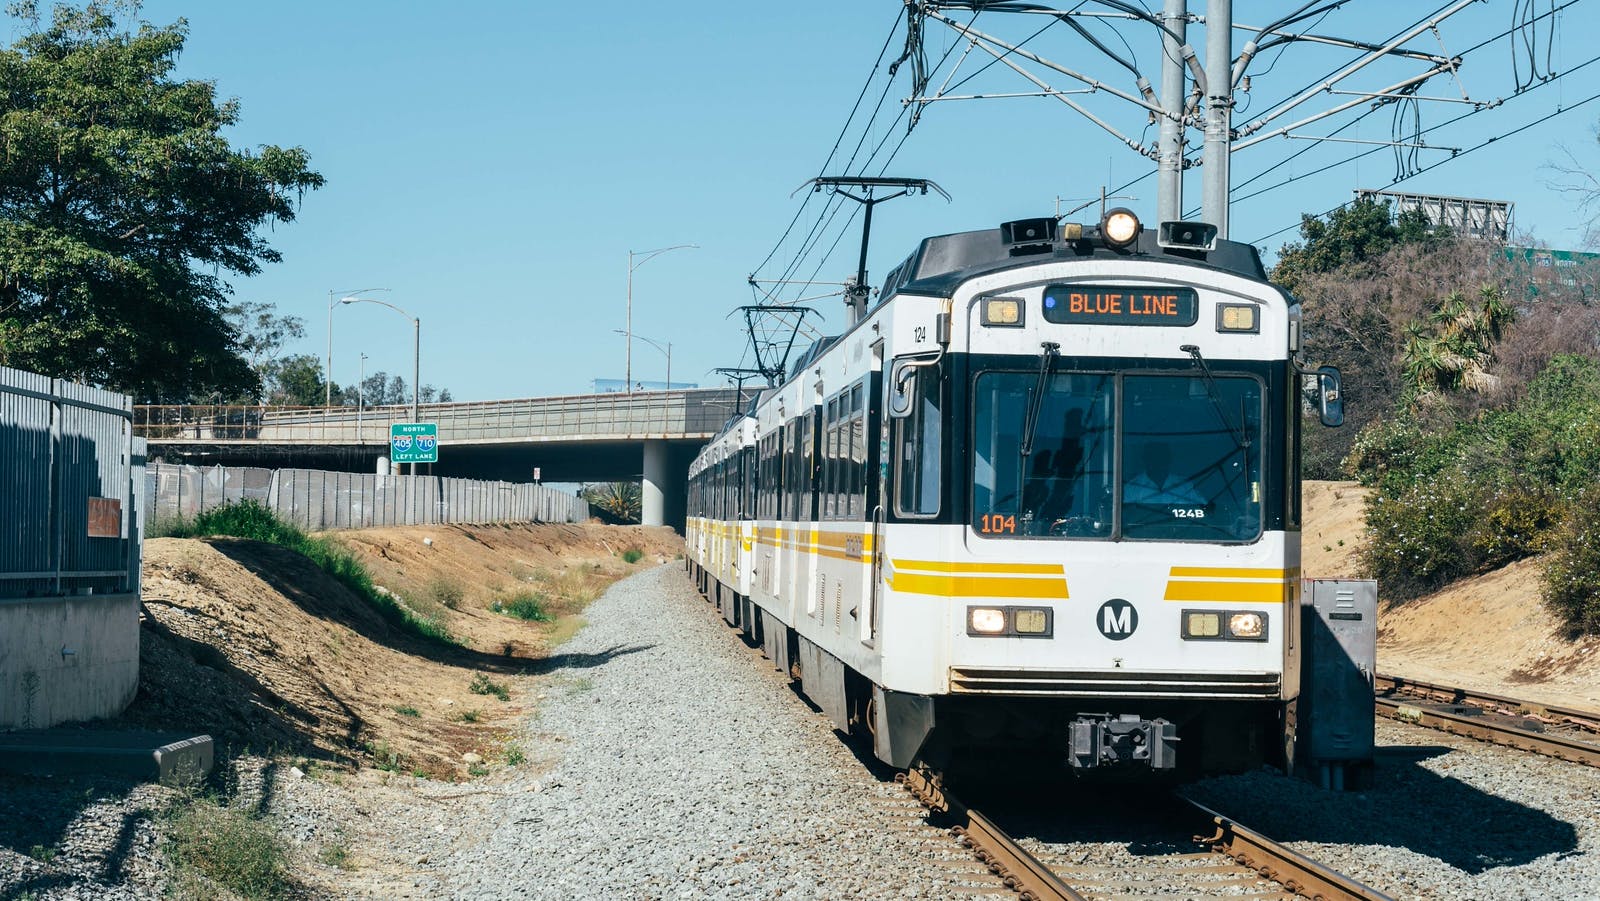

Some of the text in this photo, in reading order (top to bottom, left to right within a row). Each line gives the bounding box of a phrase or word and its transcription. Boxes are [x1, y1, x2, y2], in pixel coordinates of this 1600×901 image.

[1069, 293, 1178, 316] BLUE LINE
[914, 326, 926, 343] 124
[395, 440, 433, 448] 405 710
[1172, 508, 1205, 518] 124B
[981, 514, 1016, 533] 104
[1104, 606, 1132, 633] M
